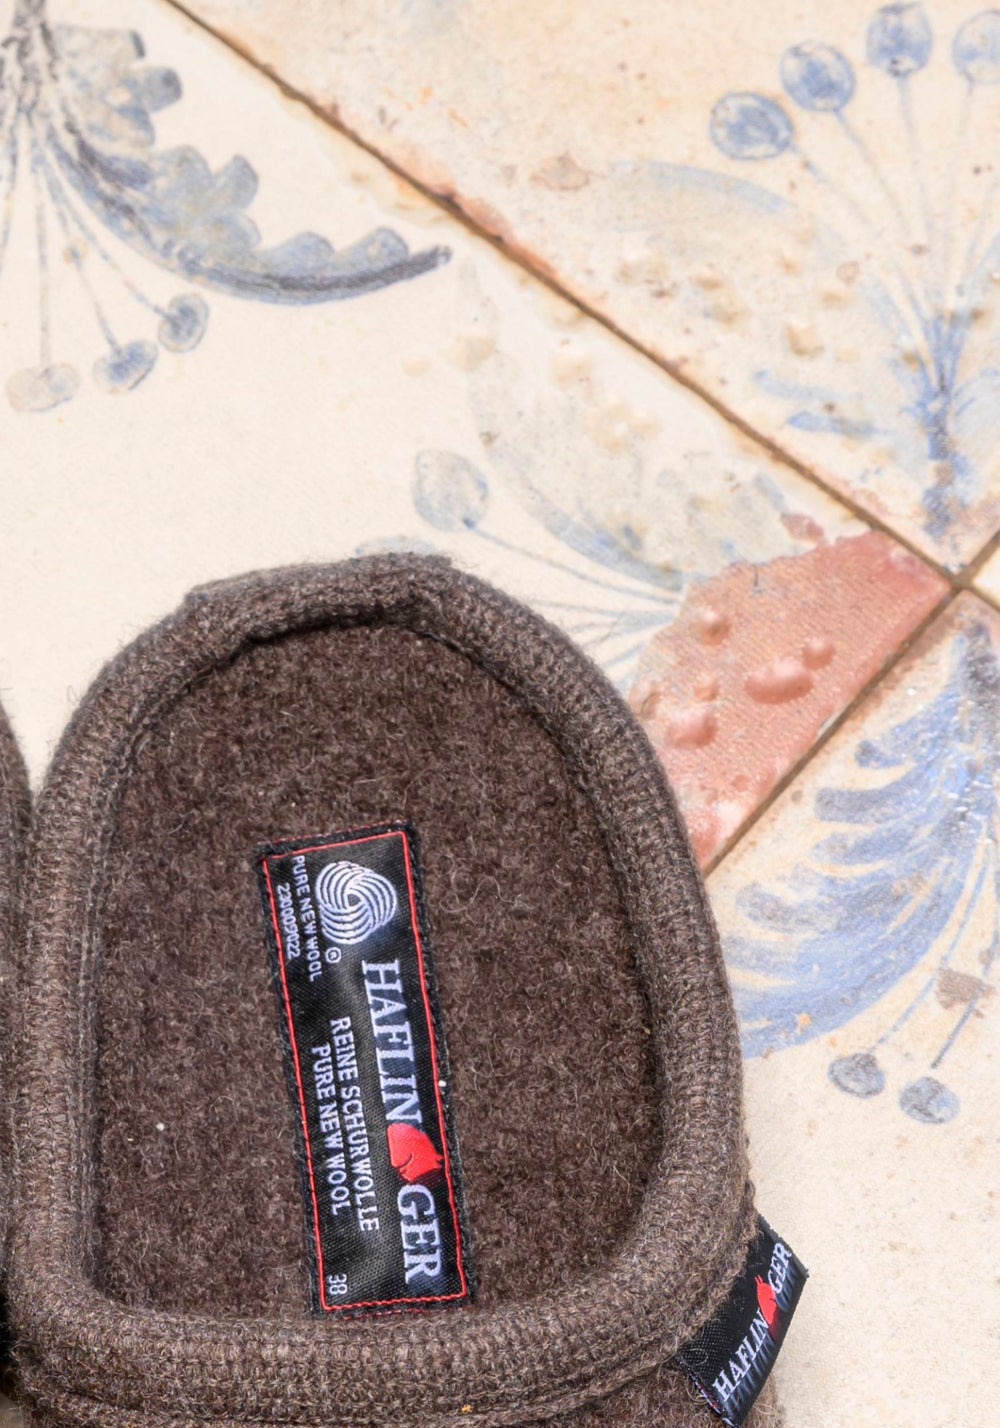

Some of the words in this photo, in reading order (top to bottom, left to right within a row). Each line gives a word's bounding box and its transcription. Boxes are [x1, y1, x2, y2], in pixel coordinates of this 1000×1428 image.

[292, 855, 311, 896] PURE
[299, 897, 317, 934] NEW
[306, 936, 322, 982] WOOL
[311, 1041, 336, 1100] PURE
[330, 1016, 360, 1083] REINE
[318, 1101, 344, 1149] NEW
[326, 1152, 351, 1215] WOOL
[328, 1273, 349, 1296] 38
